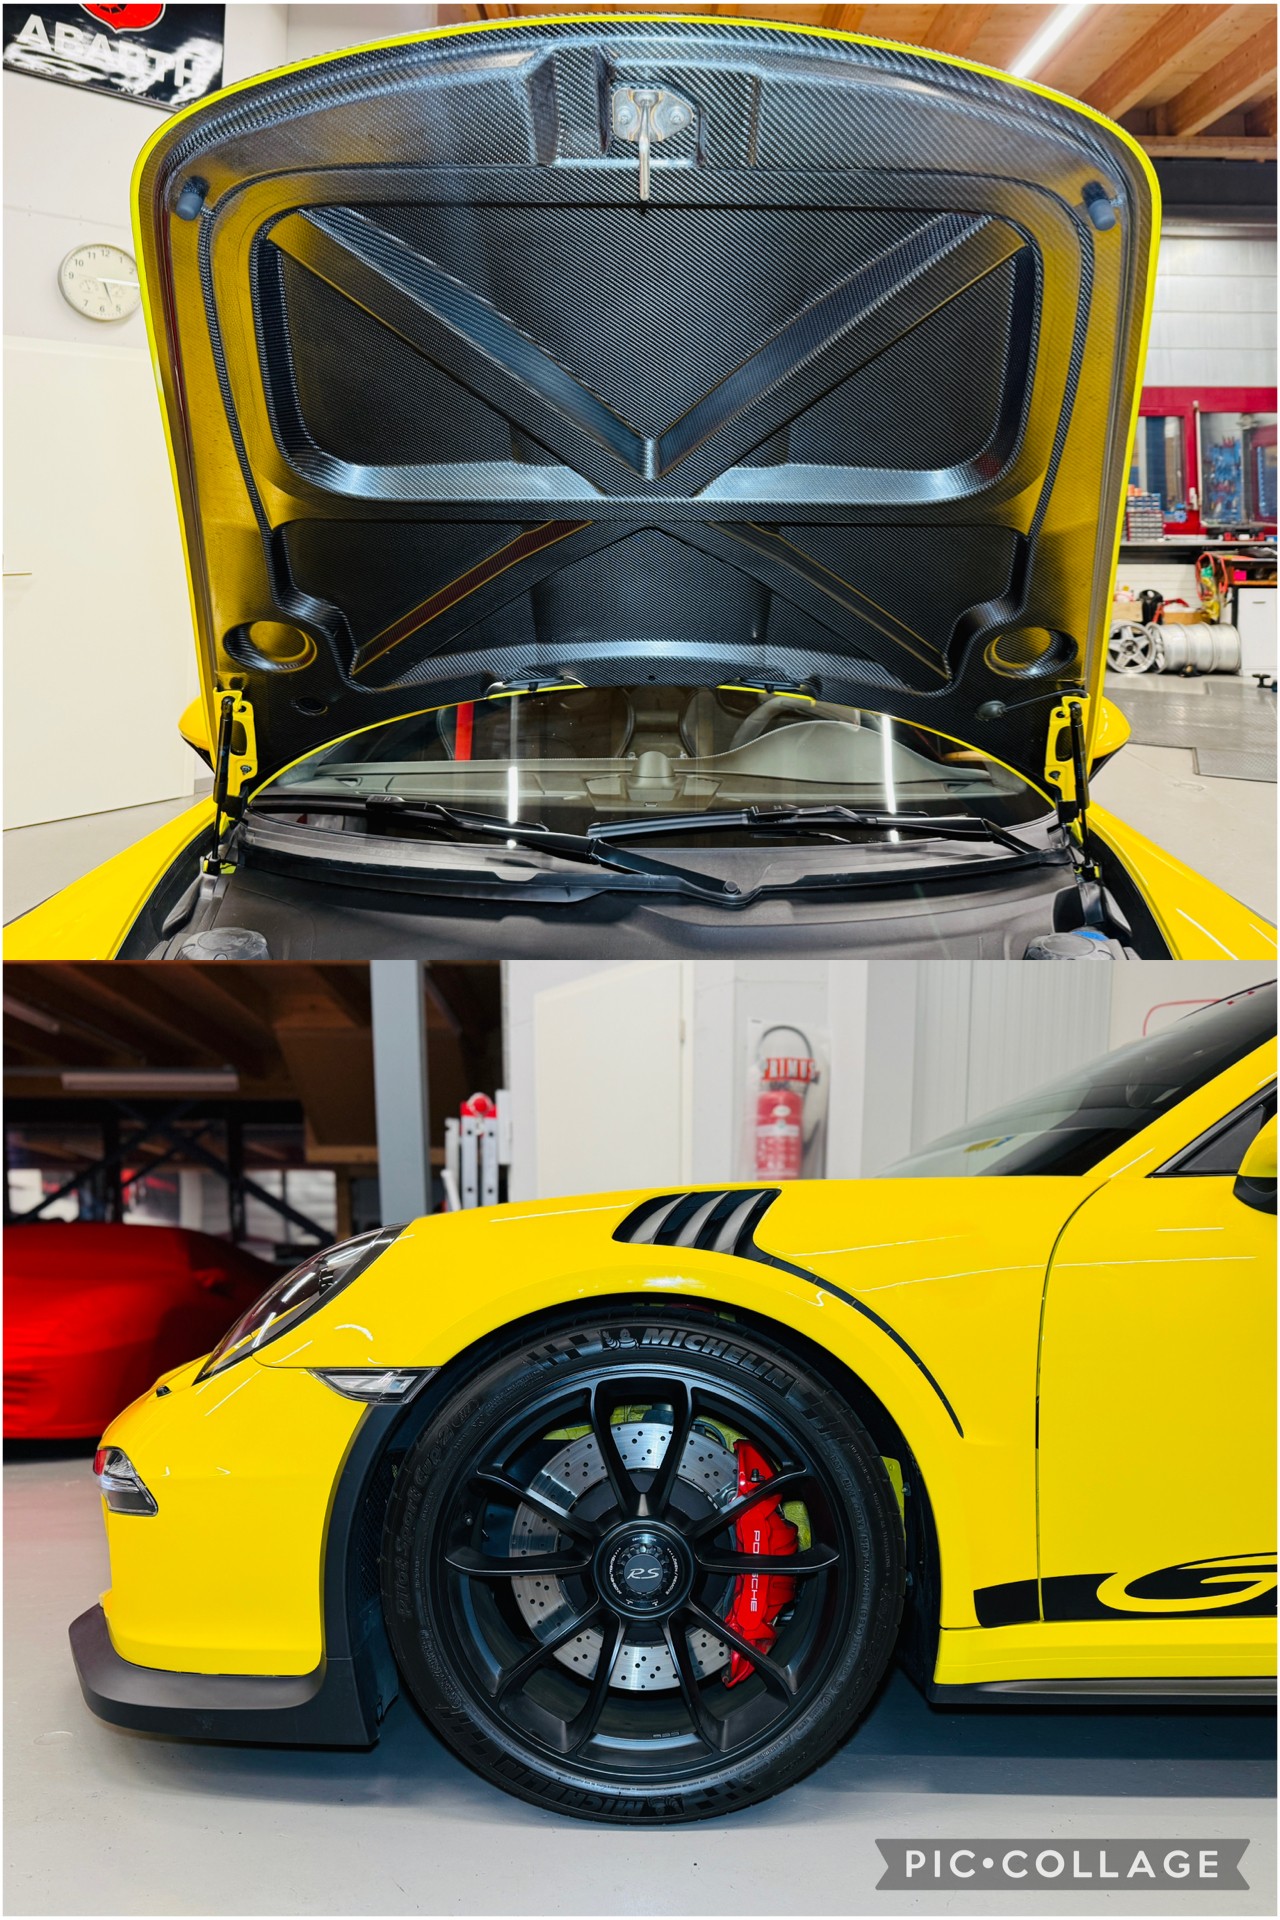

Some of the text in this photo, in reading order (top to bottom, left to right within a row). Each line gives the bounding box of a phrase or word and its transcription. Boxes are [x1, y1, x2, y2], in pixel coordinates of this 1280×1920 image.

[14, 13, 198, 88] ABARTH
[75, 259, 84, 267] 10
[641, 1328, 797, 1390] MICHELIN
[626, 1567, 660, 1580] RS
[751, 1530, 761, 1612] POCHE
[494, 1757, 646, 1817] MICHELIN
